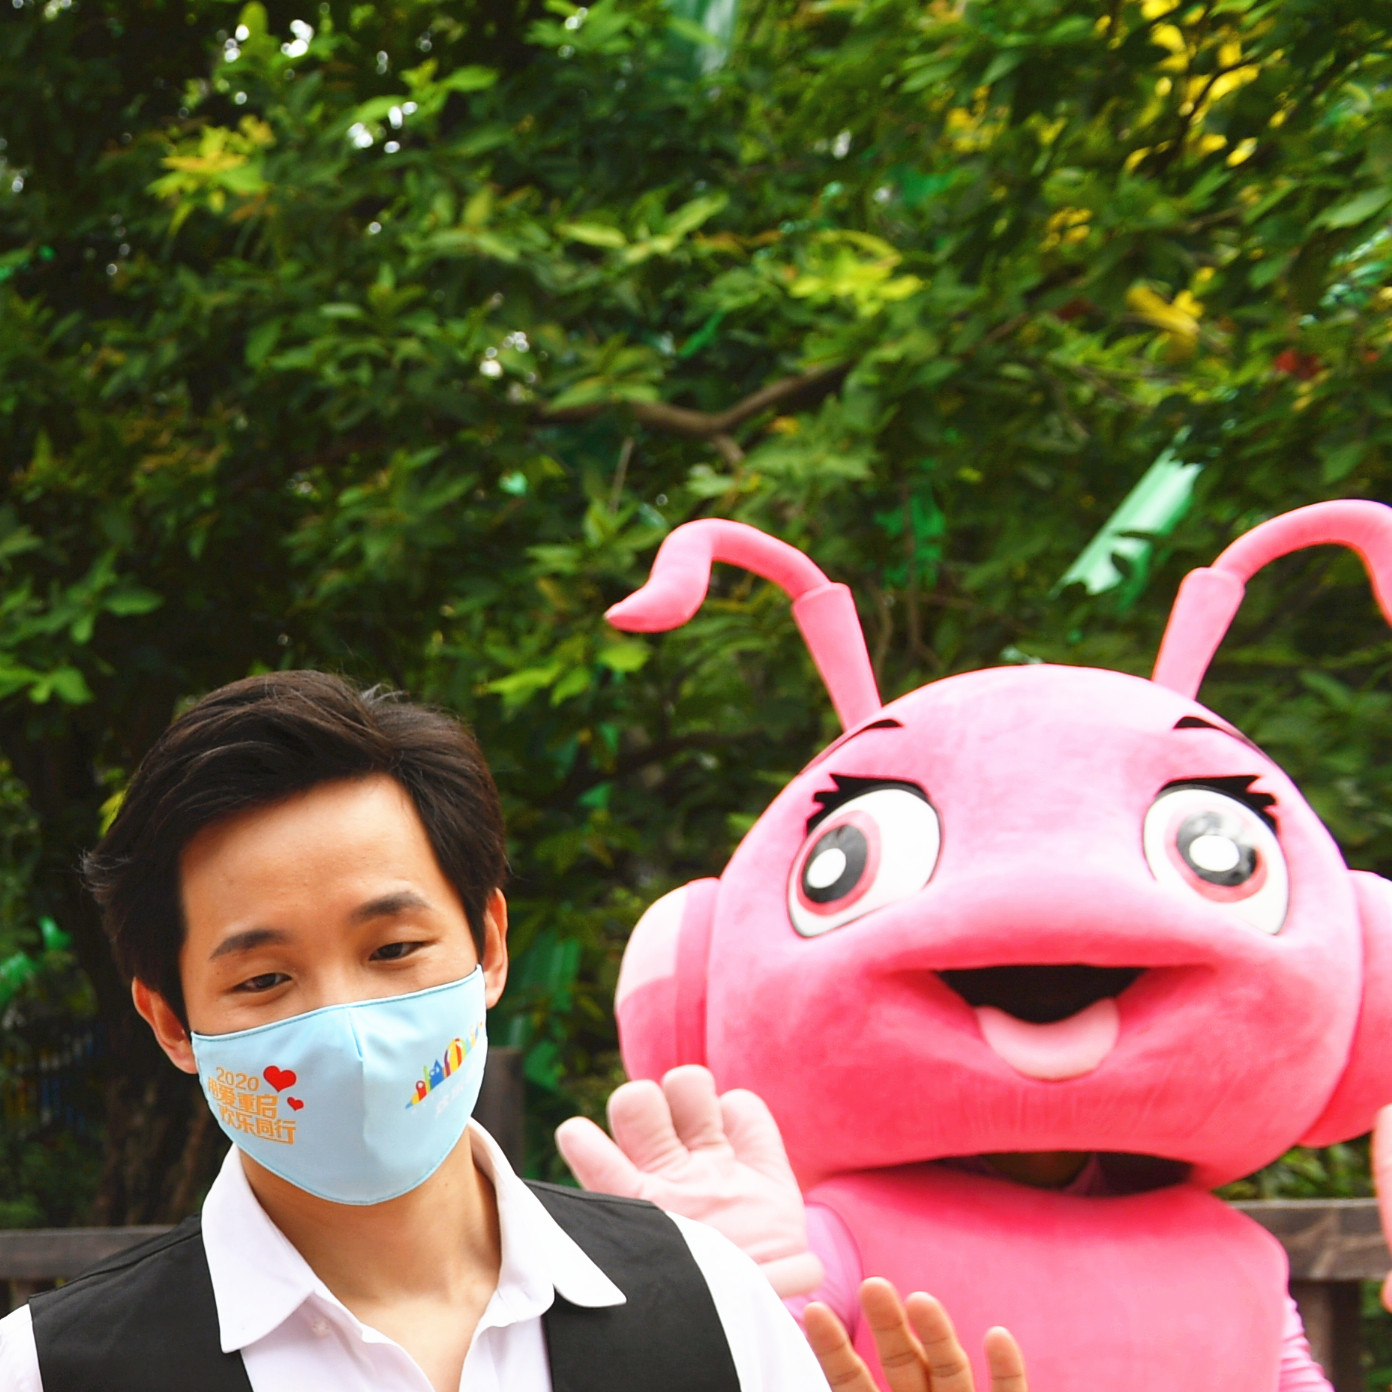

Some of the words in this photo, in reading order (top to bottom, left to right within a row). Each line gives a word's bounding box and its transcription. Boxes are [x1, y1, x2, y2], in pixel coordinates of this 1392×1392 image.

[208, 1077, 278, 1120] 用爱重启
[216, 1066, 261, 1091] 2020
[218, 1104, 296, 1145] 欢乐同行
